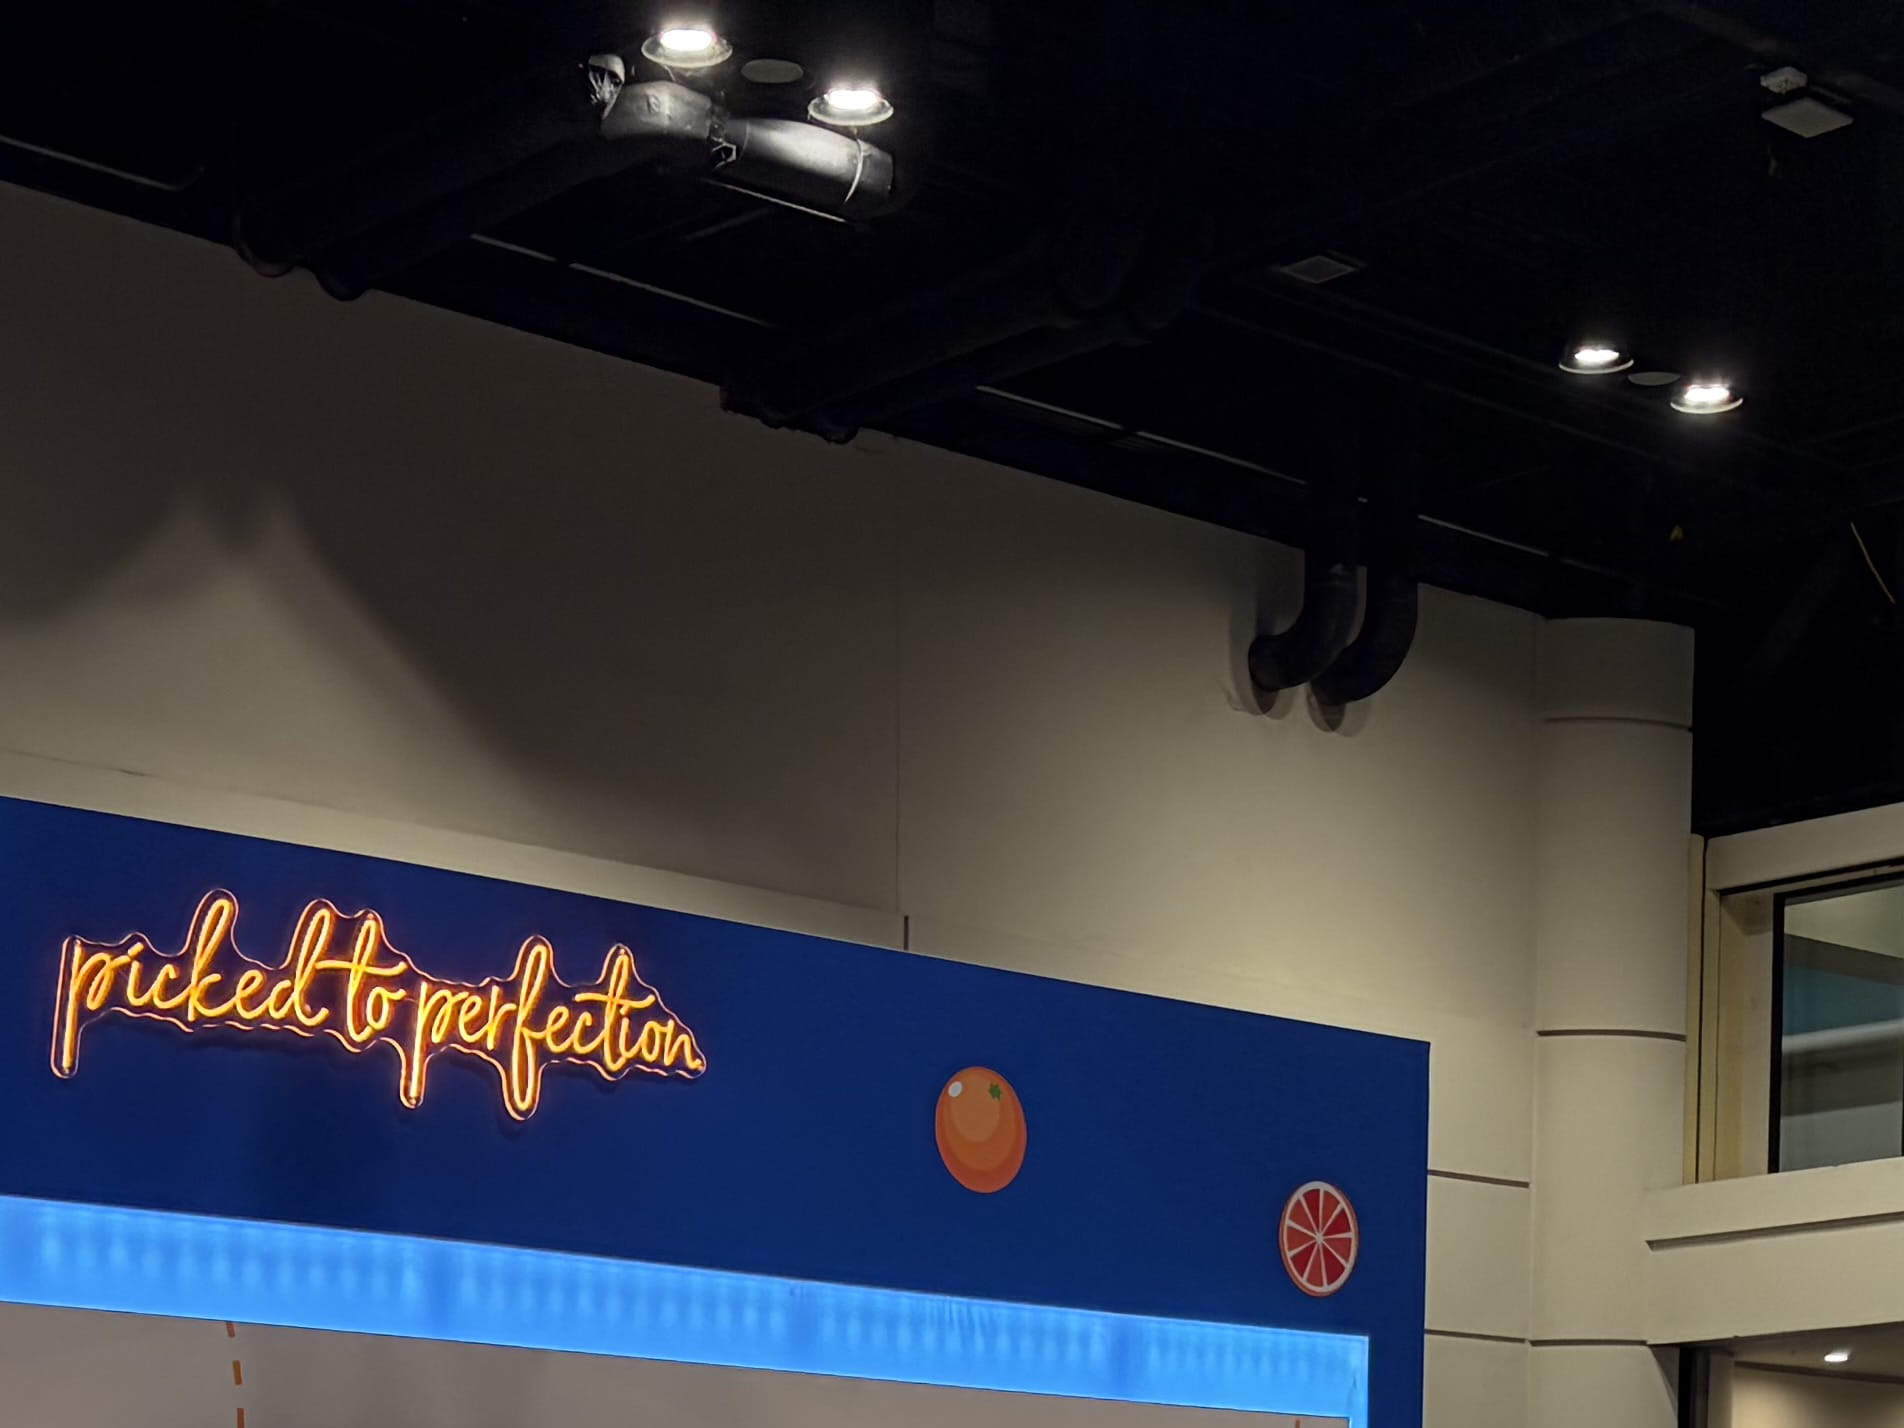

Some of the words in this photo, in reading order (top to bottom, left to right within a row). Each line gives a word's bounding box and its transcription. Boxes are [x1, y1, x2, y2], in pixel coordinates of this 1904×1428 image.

[60, 895, 329, 1074] picked
[316, 910, 408, 1042] to
[402, 935, 707, 1114] perfection
